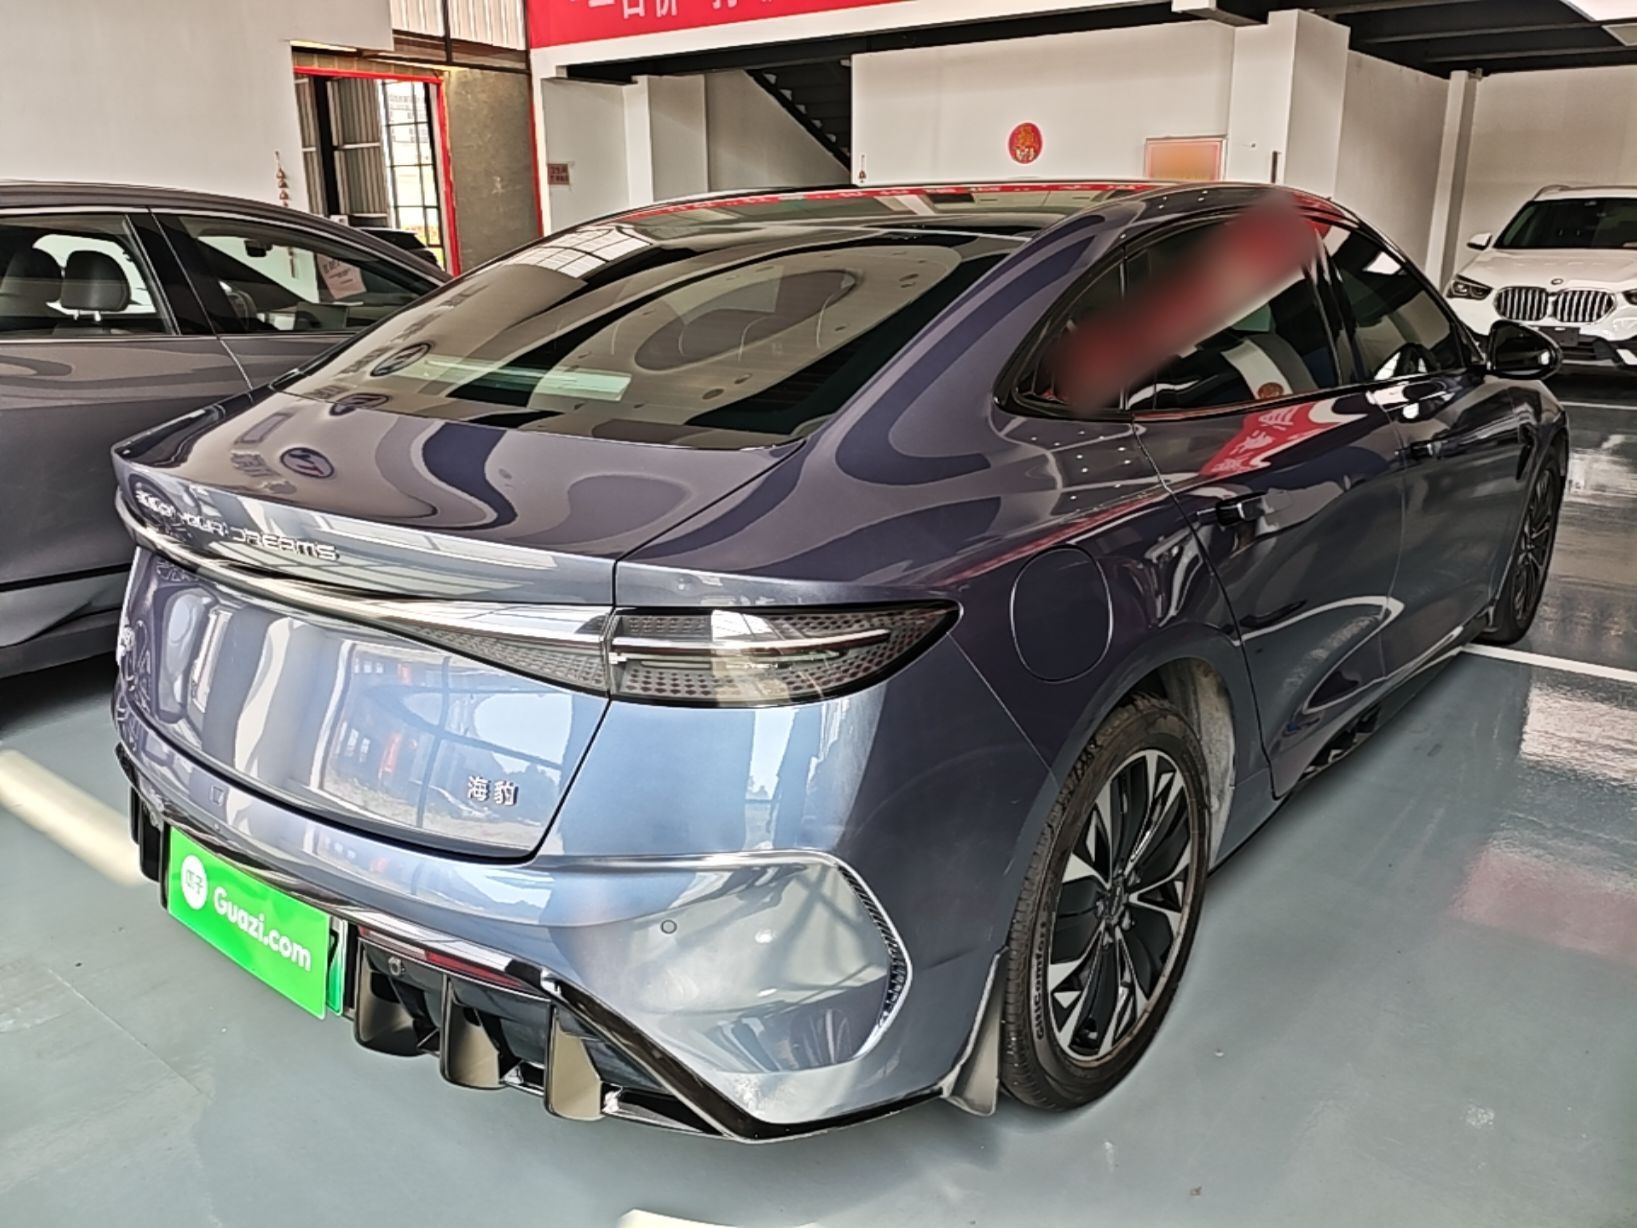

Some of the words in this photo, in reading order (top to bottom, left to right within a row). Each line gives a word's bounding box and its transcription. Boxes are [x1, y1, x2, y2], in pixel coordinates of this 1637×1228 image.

[230, 526, 340, 560] DREAMS
[468, 776, 518, 806] 海豹
[213, 885, 312, 972] Guazi.com
